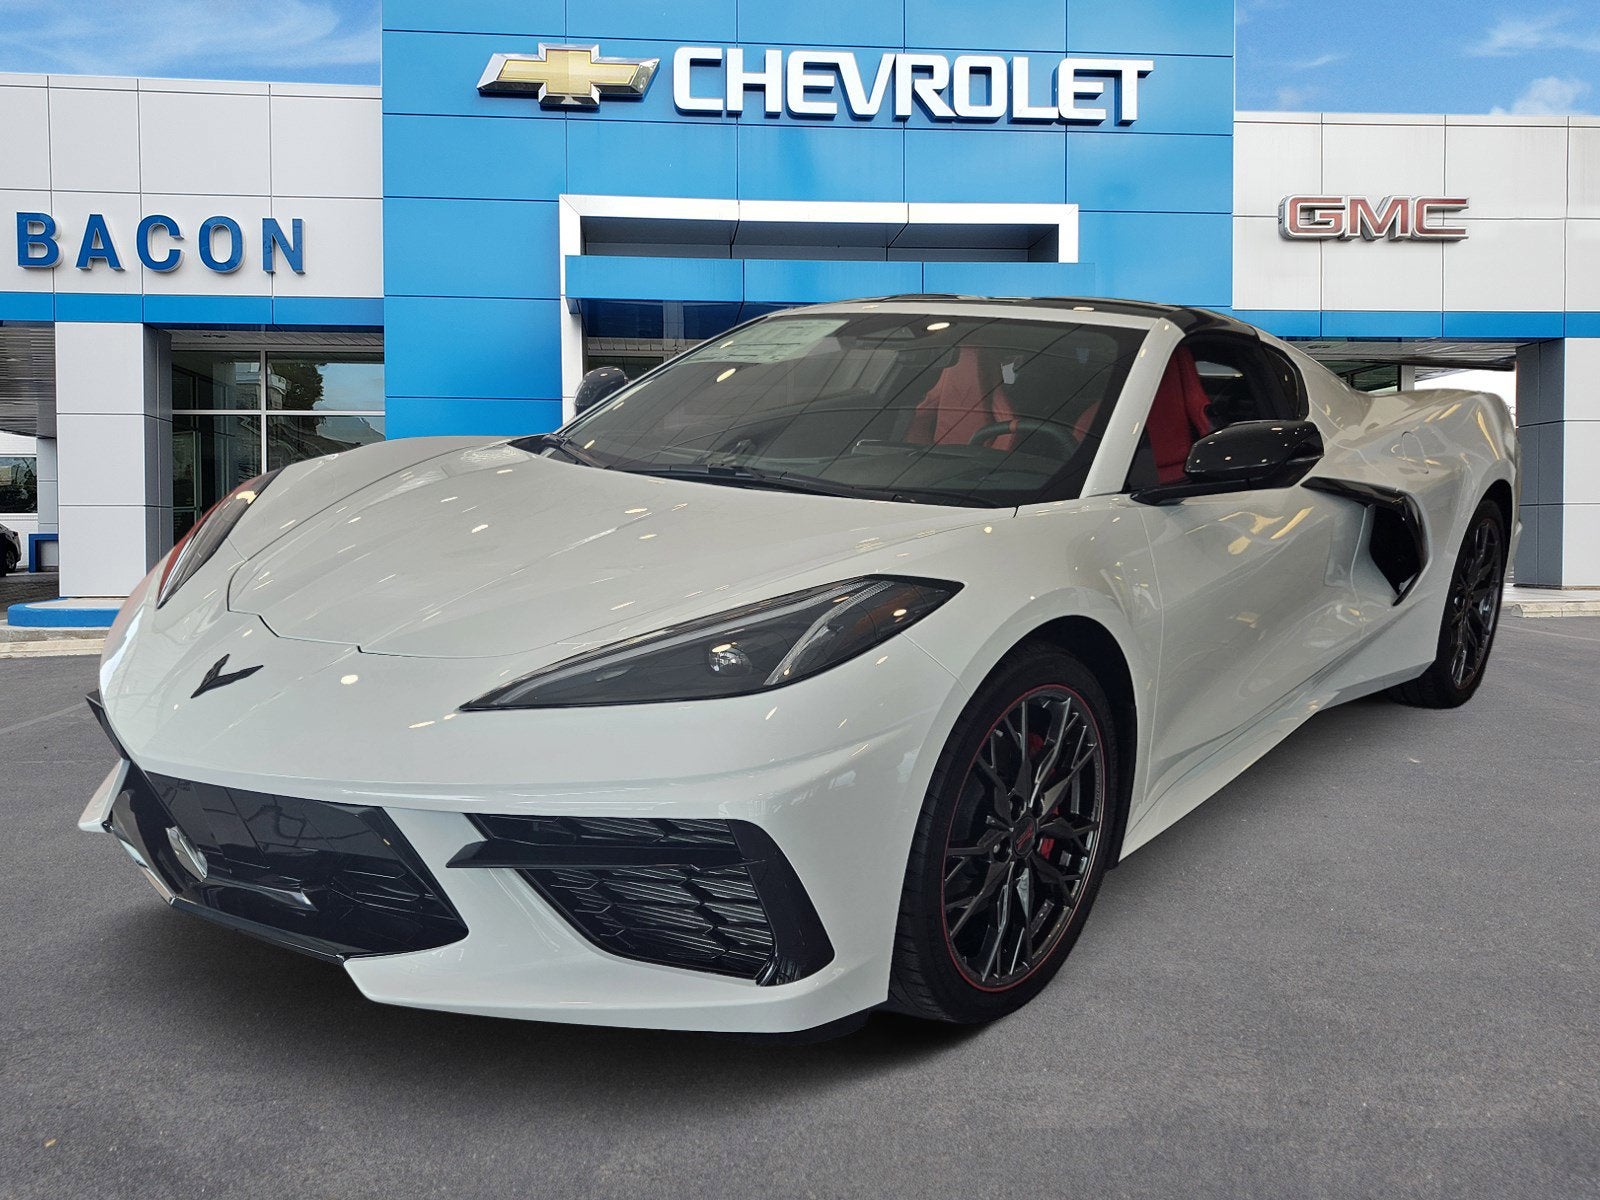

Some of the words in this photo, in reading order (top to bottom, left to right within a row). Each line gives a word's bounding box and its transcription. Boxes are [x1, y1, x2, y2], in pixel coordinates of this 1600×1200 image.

[672, 46, 1154, 123] CHEVROLET
[16, 211, 306, 274] BACON
[1281, 195, 1469, 242] GMC
